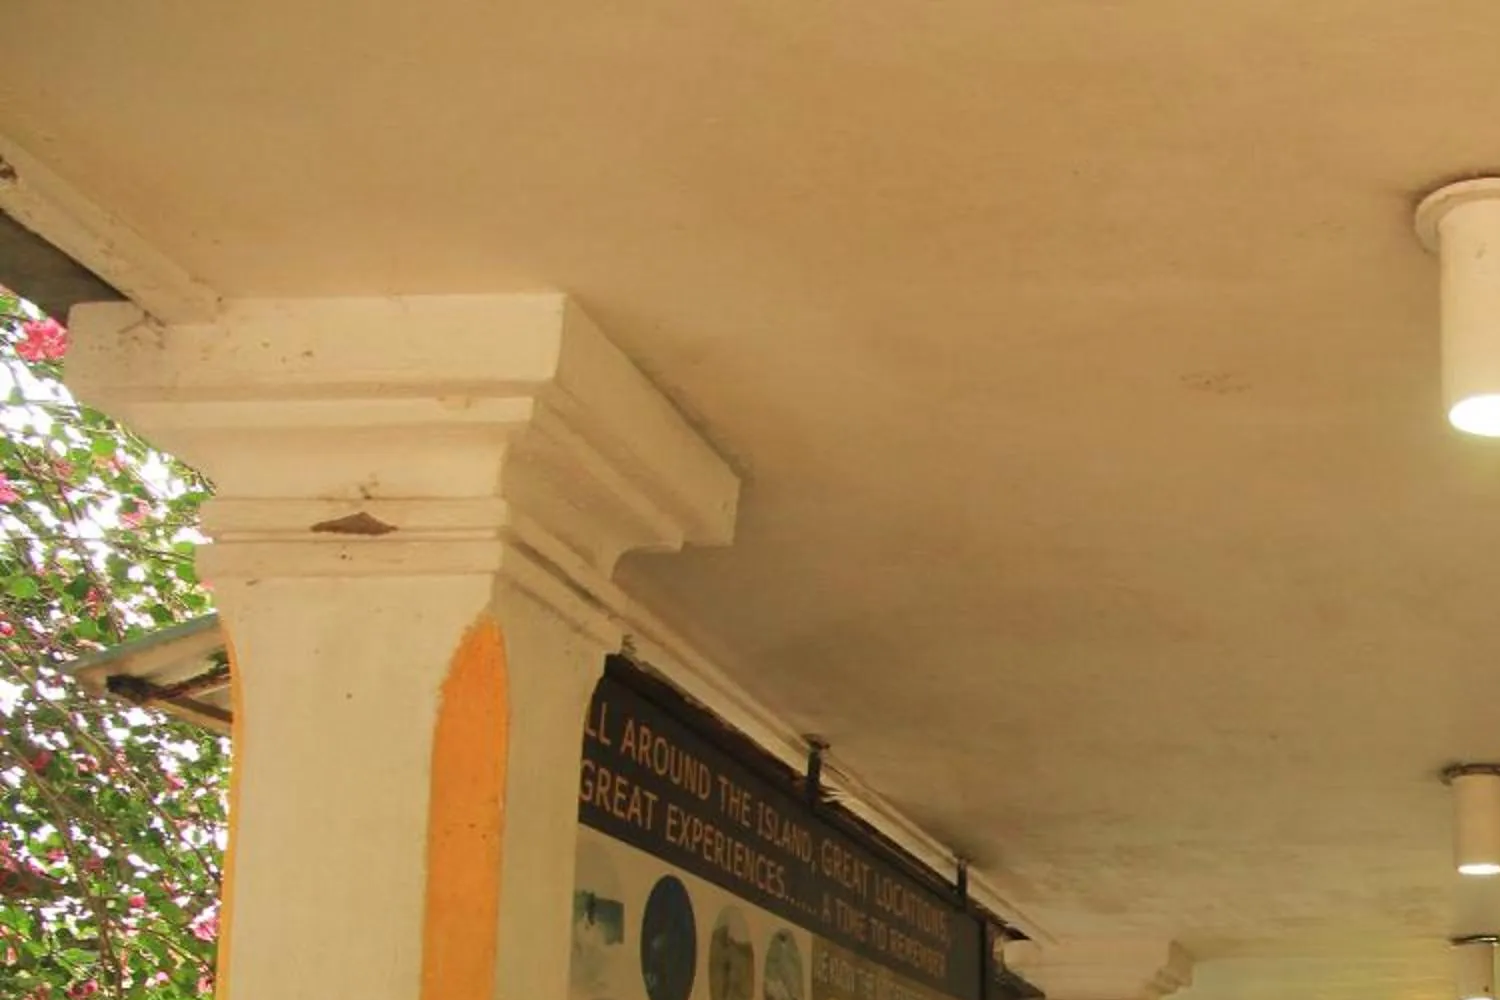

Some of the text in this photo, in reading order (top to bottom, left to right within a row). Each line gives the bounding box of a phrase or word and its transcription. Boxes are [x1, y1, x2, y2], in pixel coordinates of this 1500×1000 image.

[580, 759, 659, 830] GREAT
[621, 719, 711, 800] AROUND
[718, 775, 751, 828] THE
[757, 801, 816, 877] ISLAND,
[822, 839, 872, 900] GREAT
